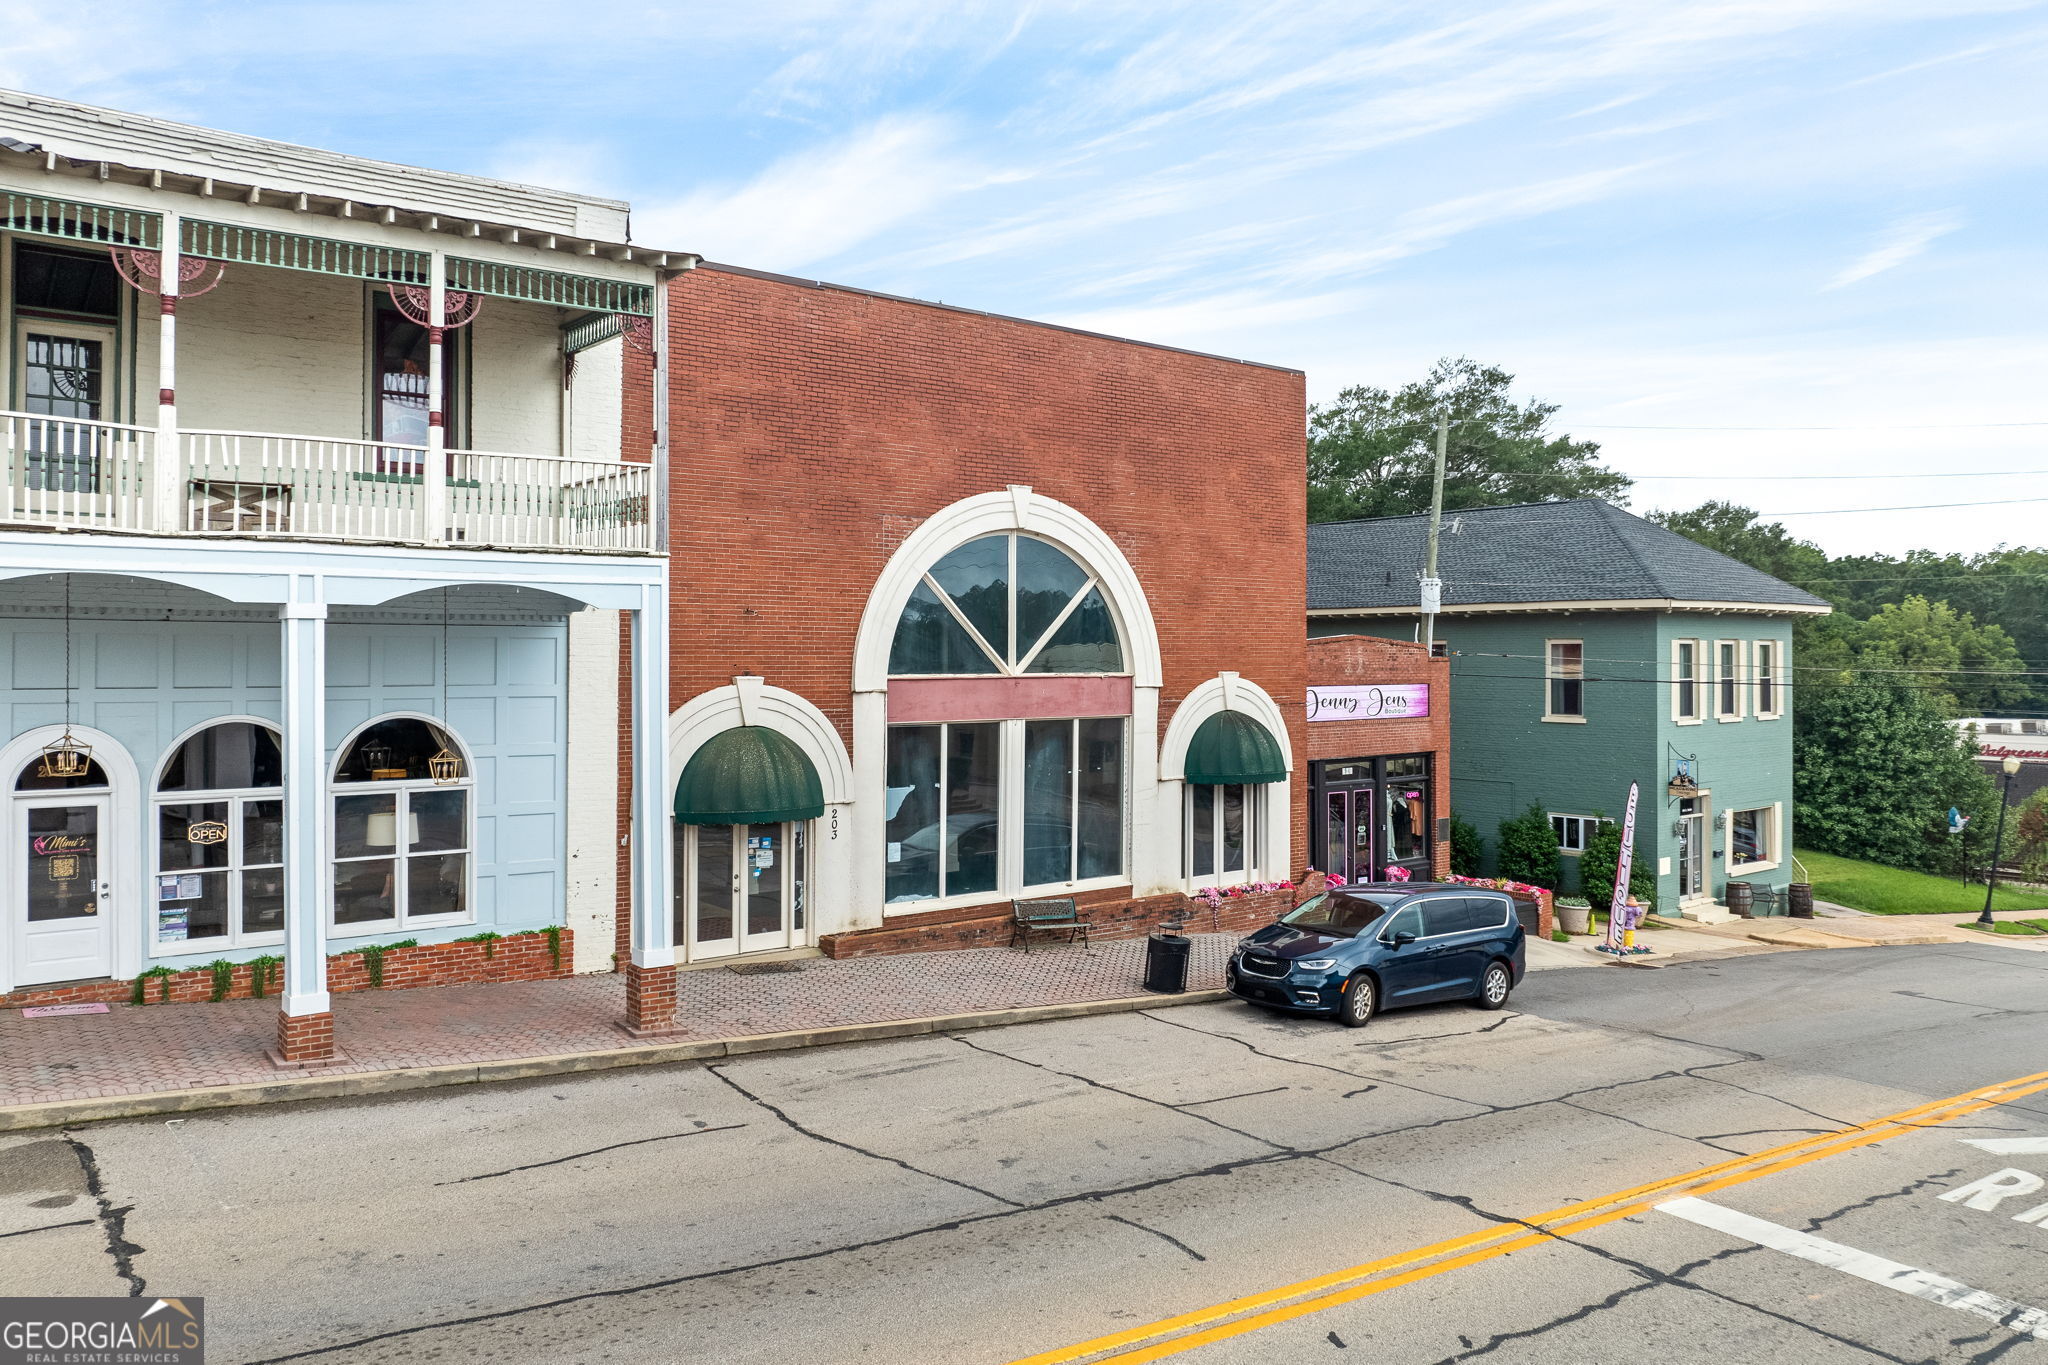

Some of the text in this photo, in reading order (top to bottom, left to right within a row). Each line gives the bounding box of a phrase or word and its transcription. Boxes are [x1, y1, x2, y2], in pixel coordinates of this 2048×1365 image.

[1306, 688, 1408, 720] Jenny Jens
[44, 834, 87, 851] Mimi's
[190, 829, 225, 840] OPEN
